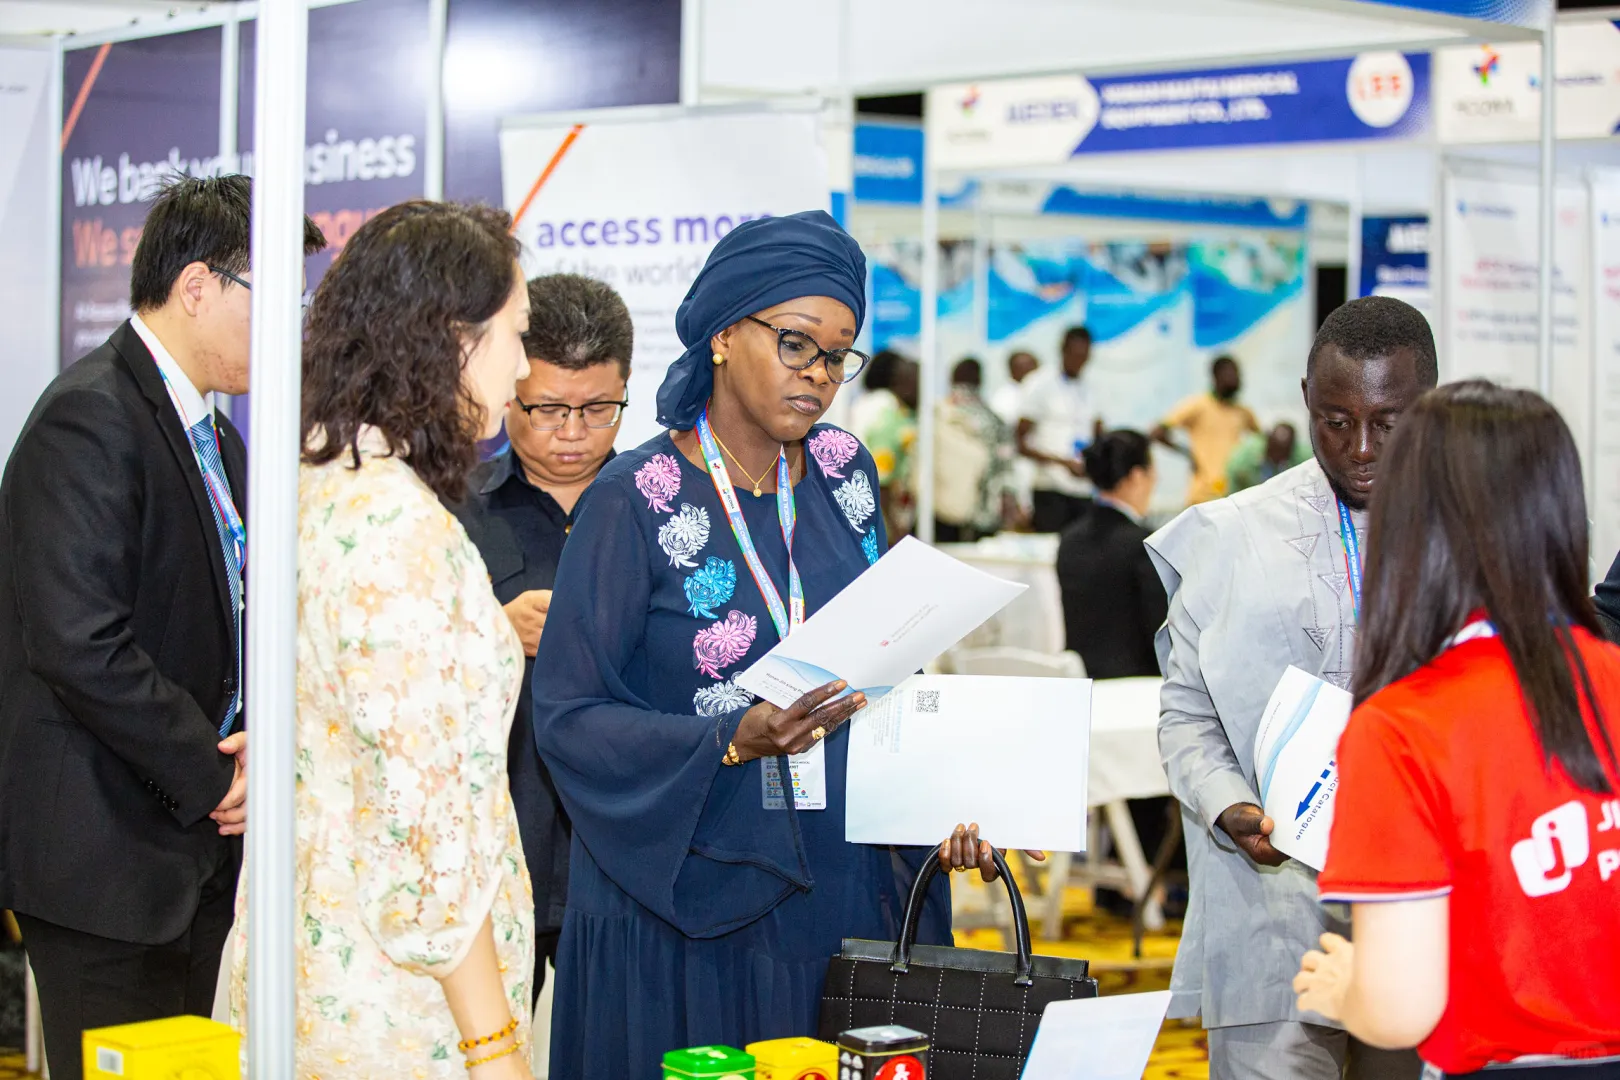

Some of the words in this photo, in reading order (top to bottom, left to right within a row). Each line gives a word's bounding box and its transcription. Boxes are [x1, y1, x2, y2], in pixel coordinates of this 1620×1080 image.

[71, 154, 117, 207] We
[118, 146, 190, 204] bank
[304, 128, 416, 185] siness
[72, 217, 118, 268] We
[537, 217, 662, 248] access
[674, 210, 775, 244] mo
[784, 501, 792, 525] MEDICAL
[1346, 531, 1355, 555] MEDICAL
[753, 563, 768, 584] AFRICA
[762, 581, 779, 606] MEDICAL
[1292, 791, 1330, 841] Catalogue
